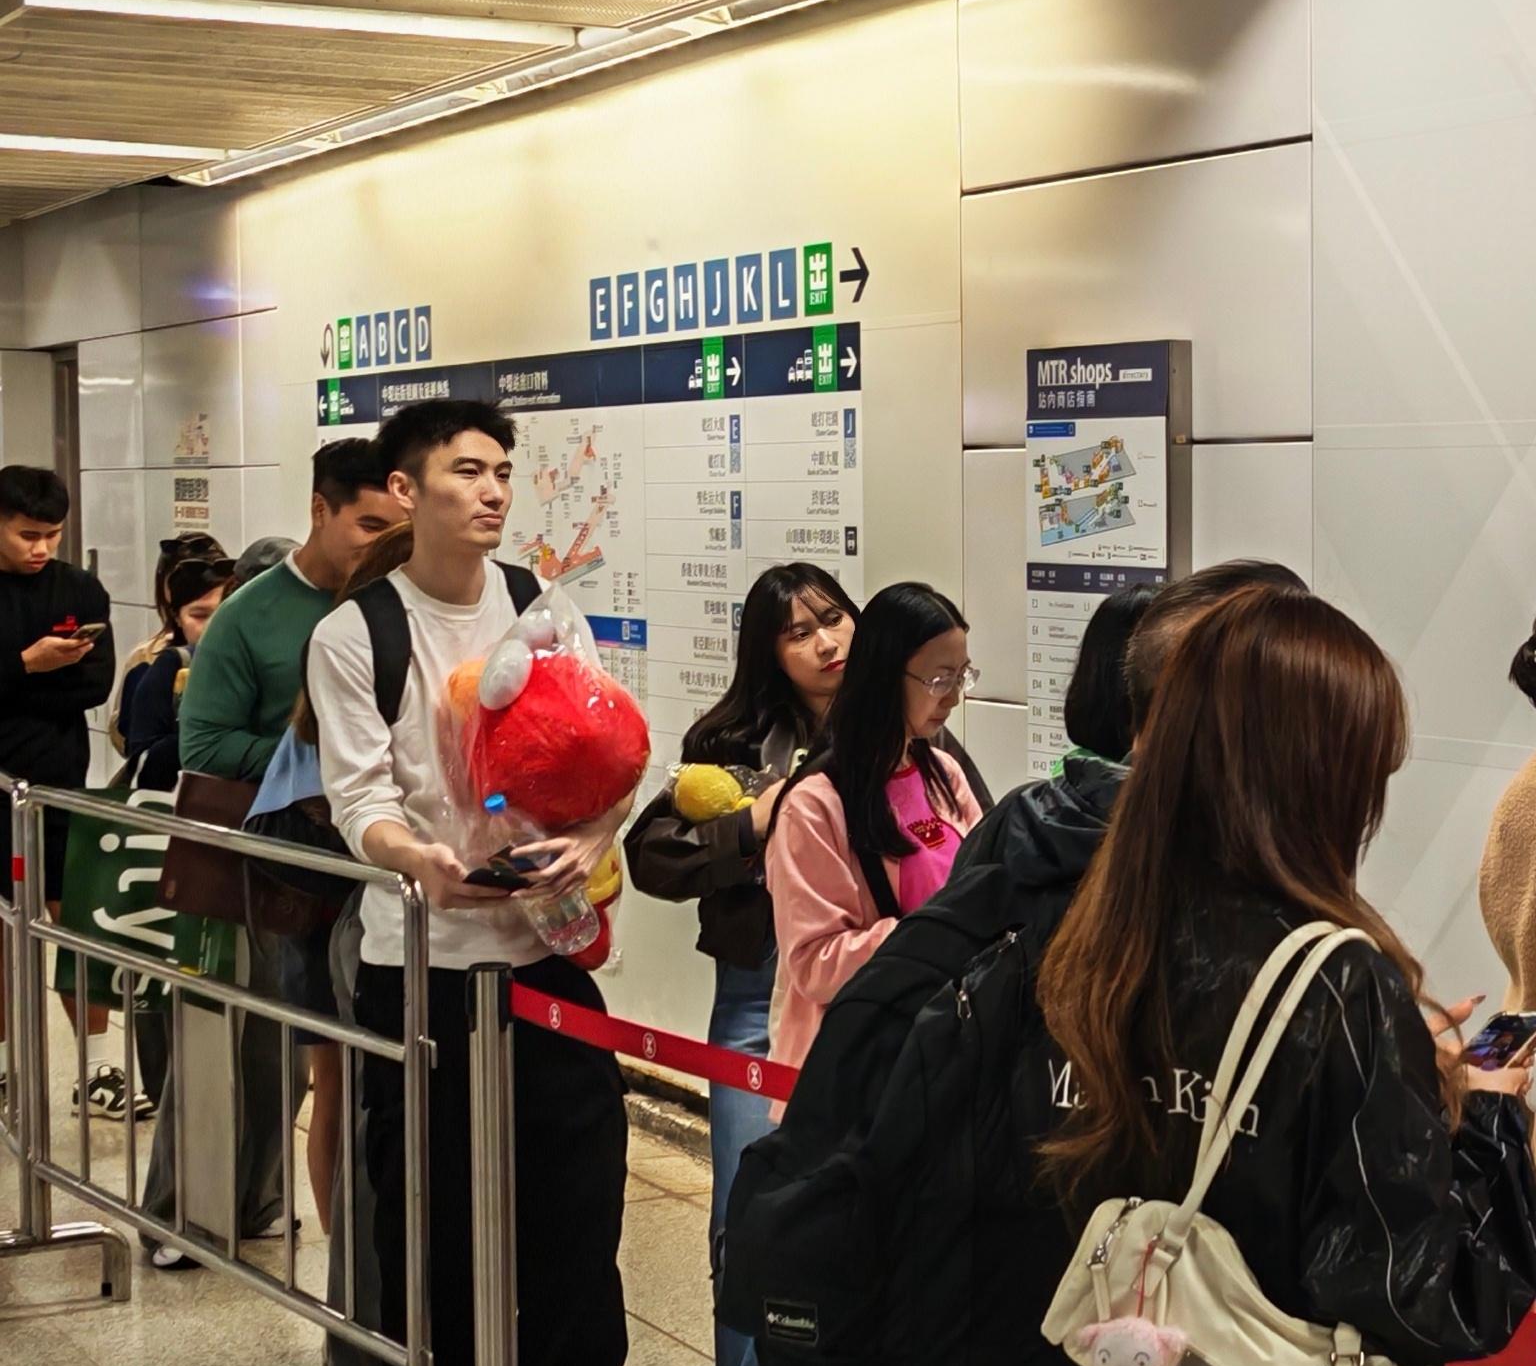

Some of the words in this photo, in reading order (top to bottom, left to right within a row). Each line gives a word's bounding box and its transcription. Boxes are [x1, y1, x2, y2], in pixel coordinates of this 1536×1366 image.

[596, 288, 607, 330] E
[623, 284, 633, 326] F
[650, 279, 664, 323] G
[679, 274, 693, 319] H
[712, 270, 721, 316] J
[743, 266, 758, 312] K
[777, 262, 790, 308] L
[809, 290, 828, 306] EXIT
[358, 324, 369, 360] A
[378, 321, 388, 357] B
[398, 318, 408, 354] C
[417, 315, 429, 352] D
[818, 373, 832, 385] EXIT
[1038, 359, 1068, 386] MTR
[1070, 357, 1112, 390] shops
[707, 382, 720, 393] EXIT
[1038, 390, 1096, 409] 站內商店指南
[732, 419, 739, 440] E
[846, 413, 853, 434] J
[733, 495, 740, 515] F
[734, 608, 742, 627] G
